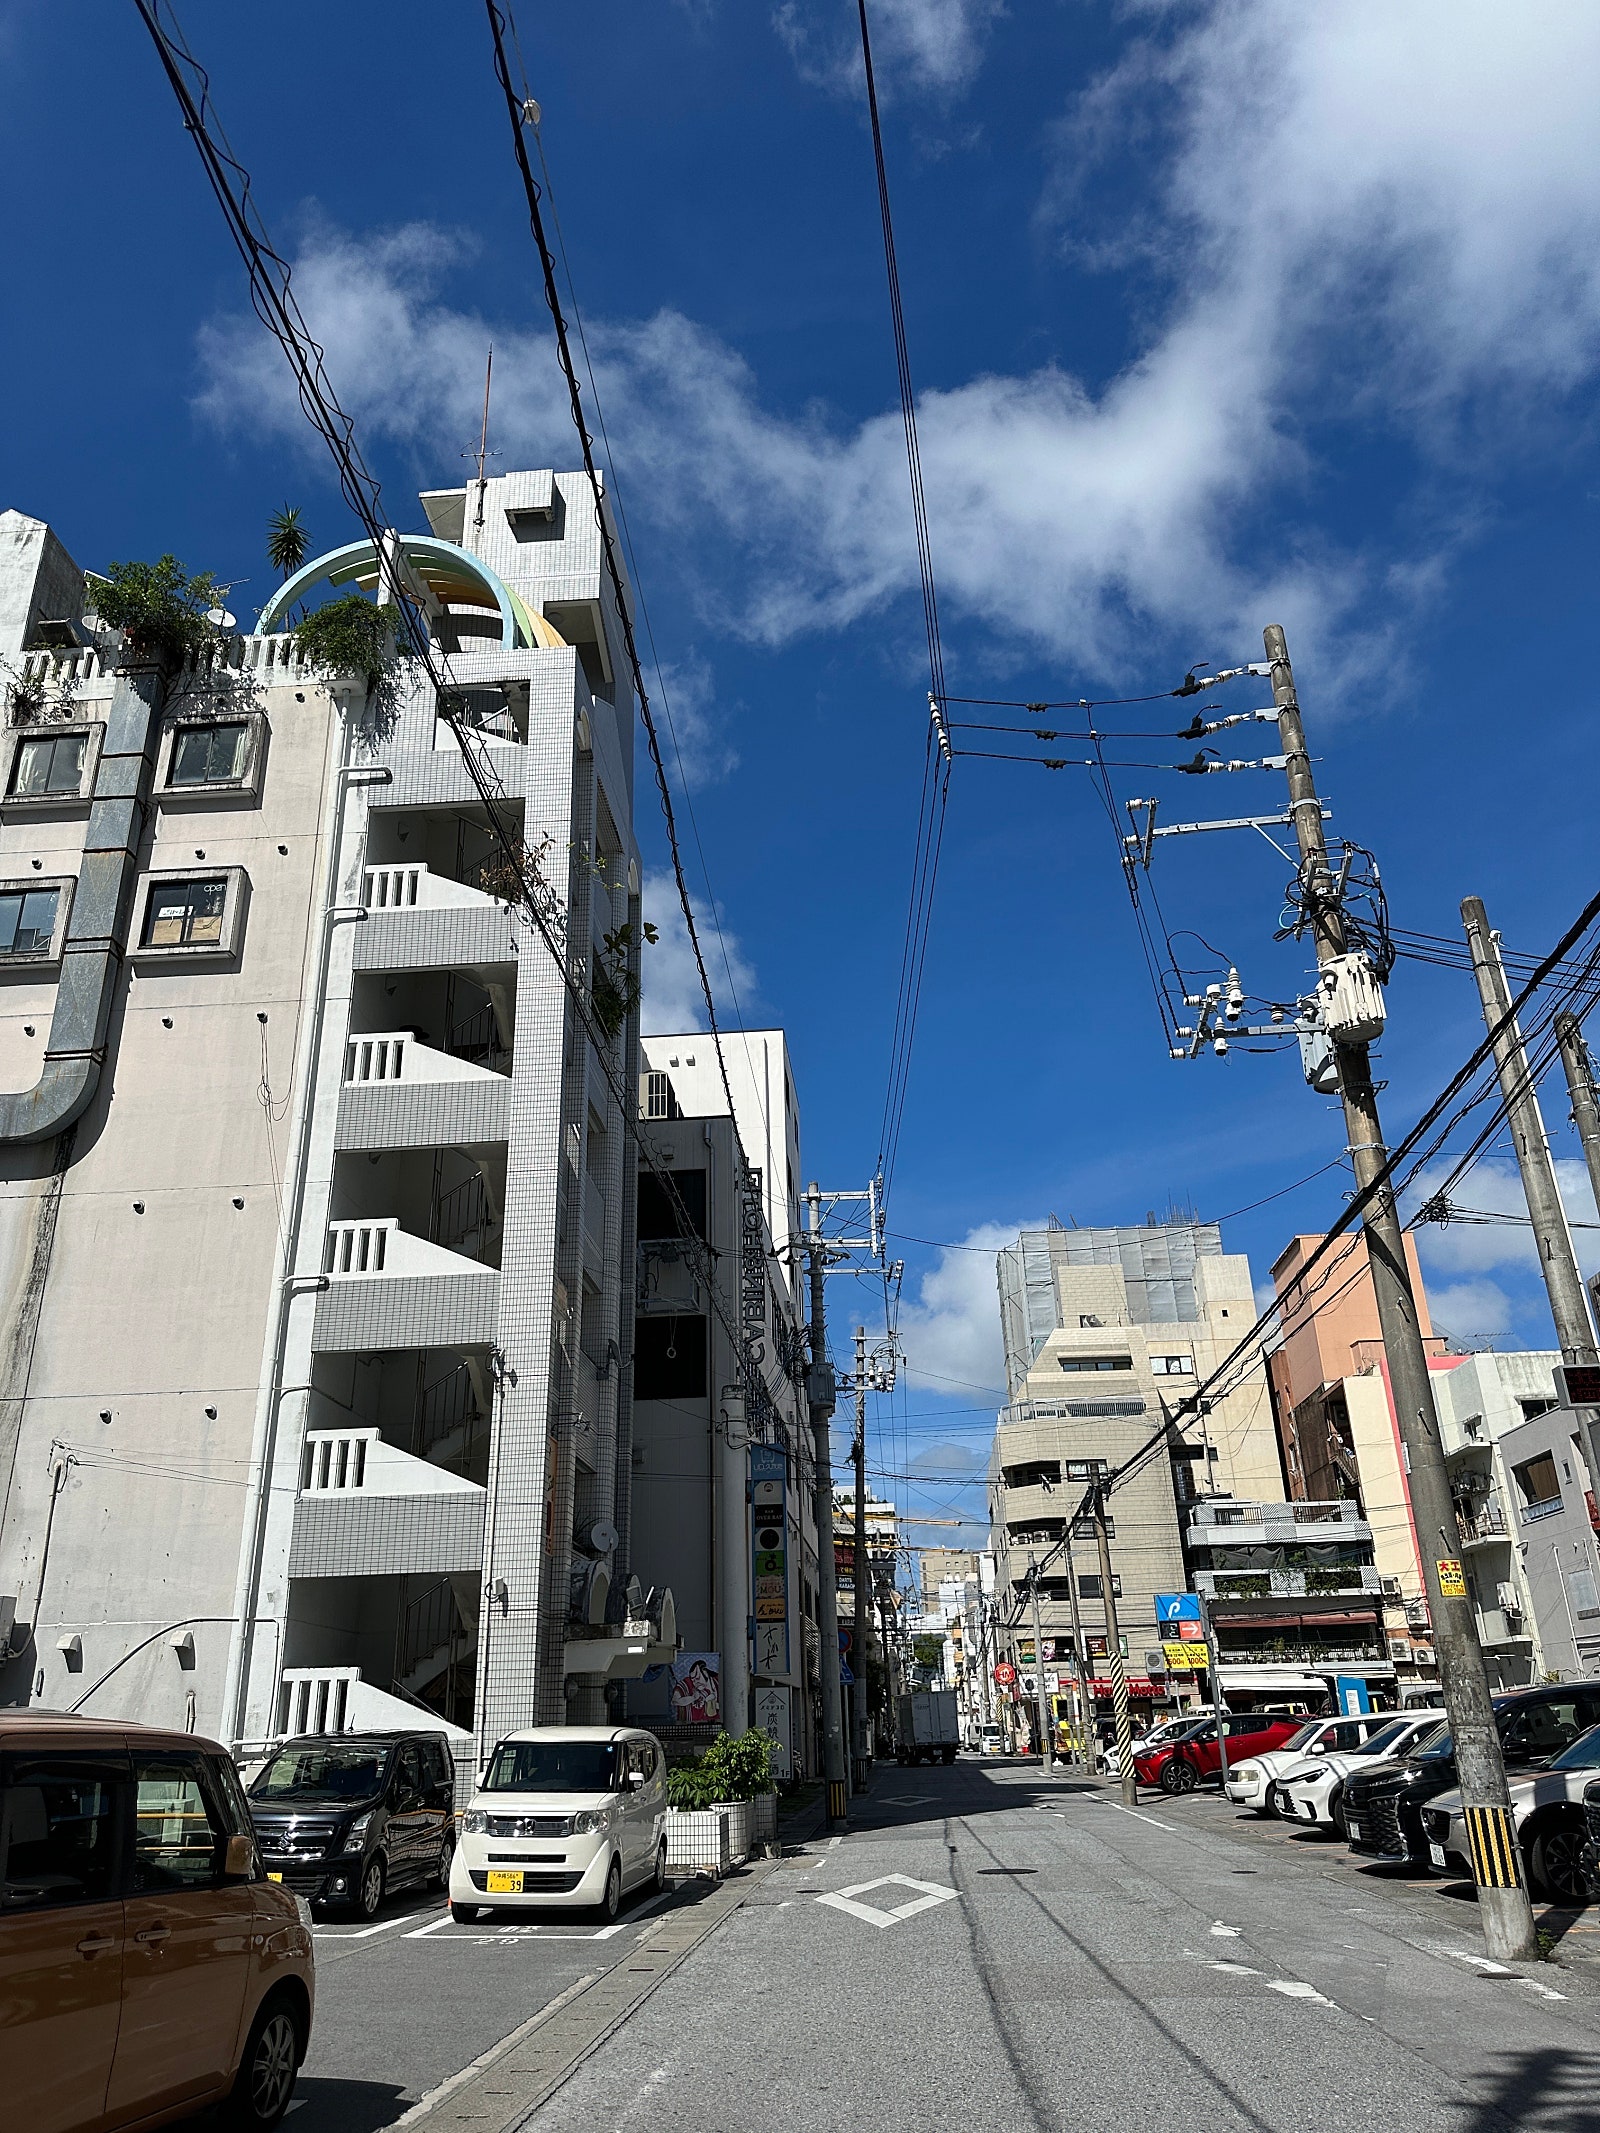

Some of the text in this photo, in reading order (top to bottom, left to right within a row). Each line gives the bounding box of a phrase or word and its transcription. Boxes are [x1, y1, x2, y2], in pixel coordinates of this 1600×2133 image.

[203, 884, 227, 896] open
[1439, 1561, 1460, 1572] 大工
[1129, 1683, 1166, 1697] Motto
[510, 1880, 521, 1891] 39
